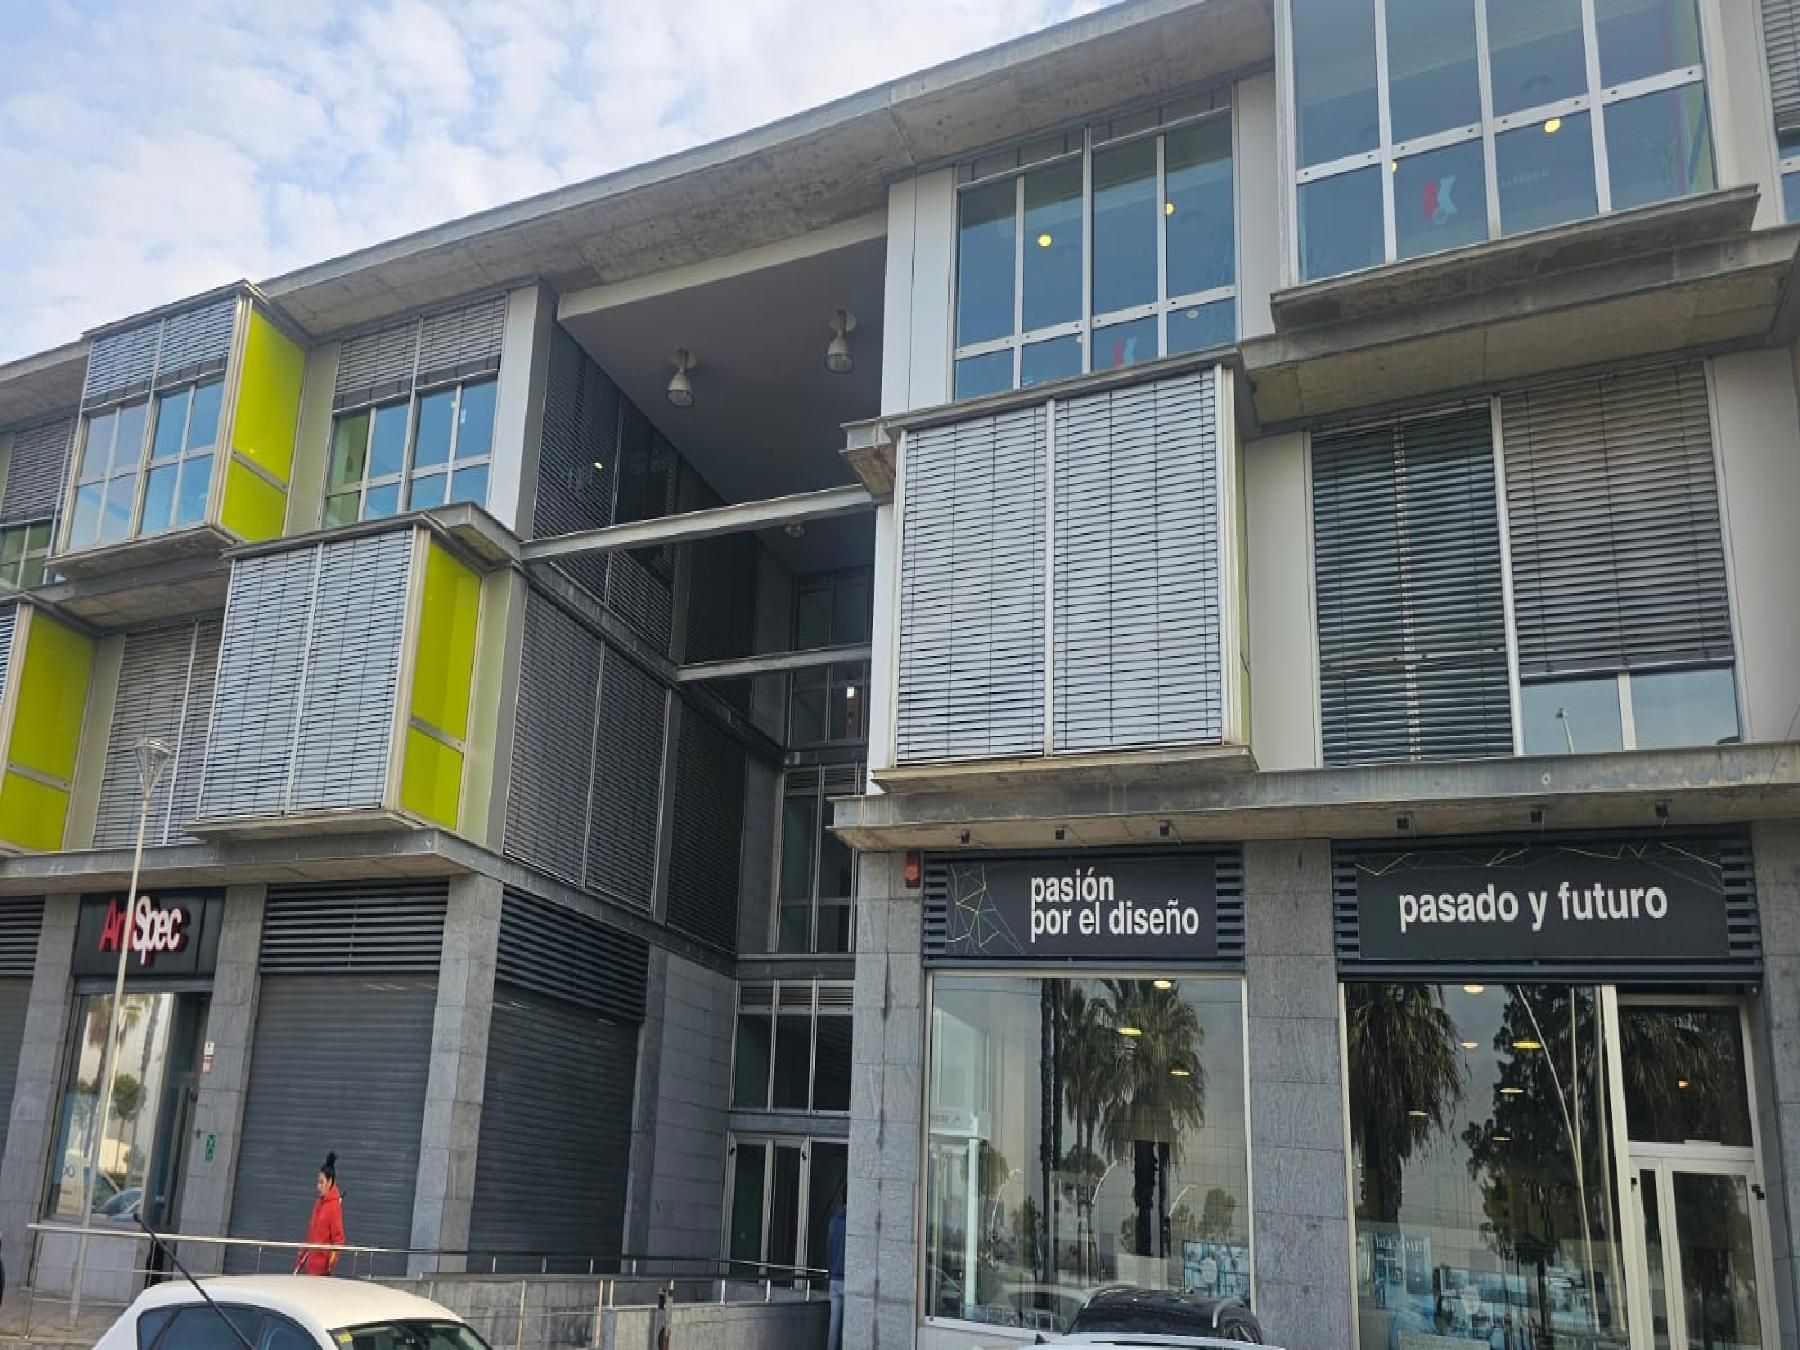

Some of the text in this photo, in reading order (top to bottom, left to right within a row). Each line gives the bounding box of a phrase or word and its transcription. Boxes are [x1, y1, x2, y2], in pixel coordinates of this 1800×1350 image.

[1031, 866, 1115, 911] pasión
[1399, 881, 1669, 933] pasado y futuro
[1031, 898, 1200, 943] por el diseño
